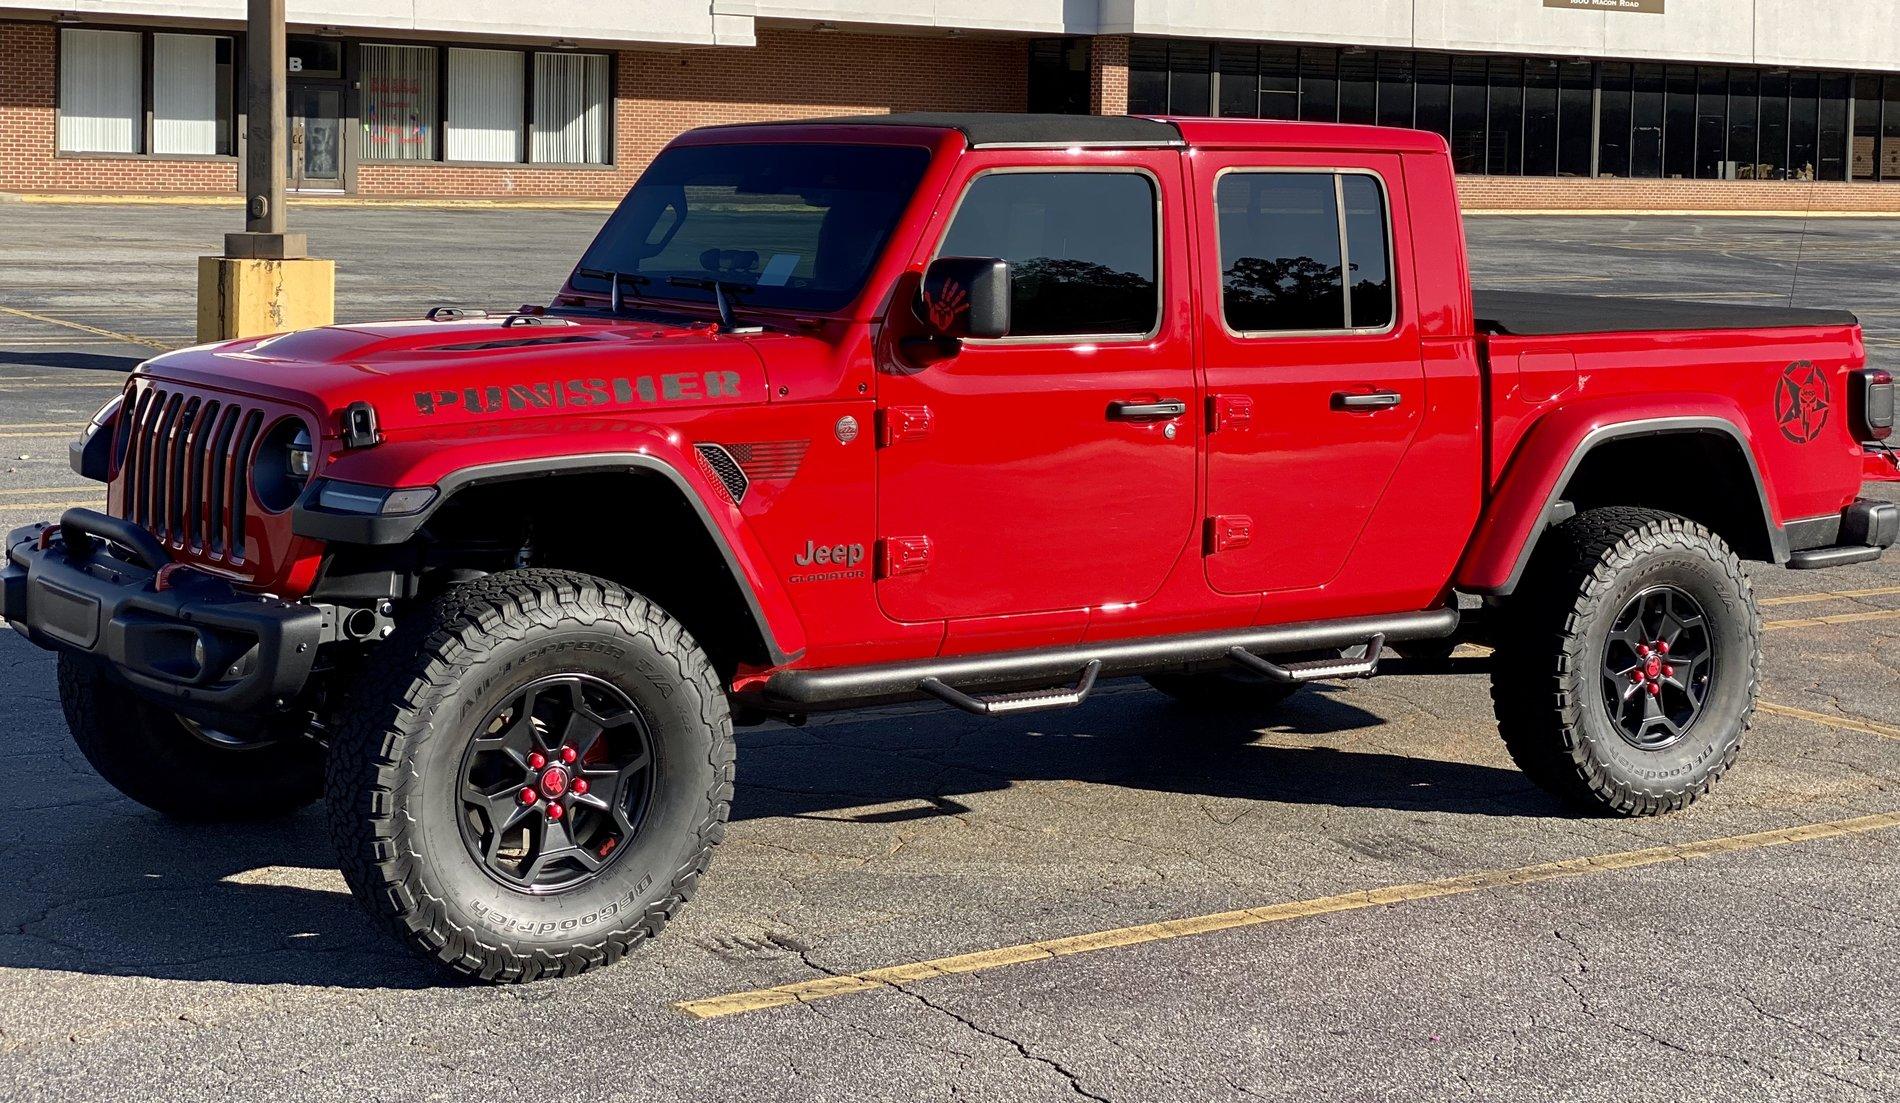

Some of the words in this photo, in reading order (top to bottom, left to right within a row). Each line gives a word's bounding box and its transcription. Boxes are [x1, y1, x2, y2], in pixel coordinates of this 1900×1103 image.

[289, 57, 302, 72] B
[413, 371, 741, 416] PUNISHER
[795, 540, 865, 568] Jeep
[788, 570, 865, 583] GLADIATOR
[634, 657, 674, 700] T/A
[469, 873, 654, 937] BFGoodrich
